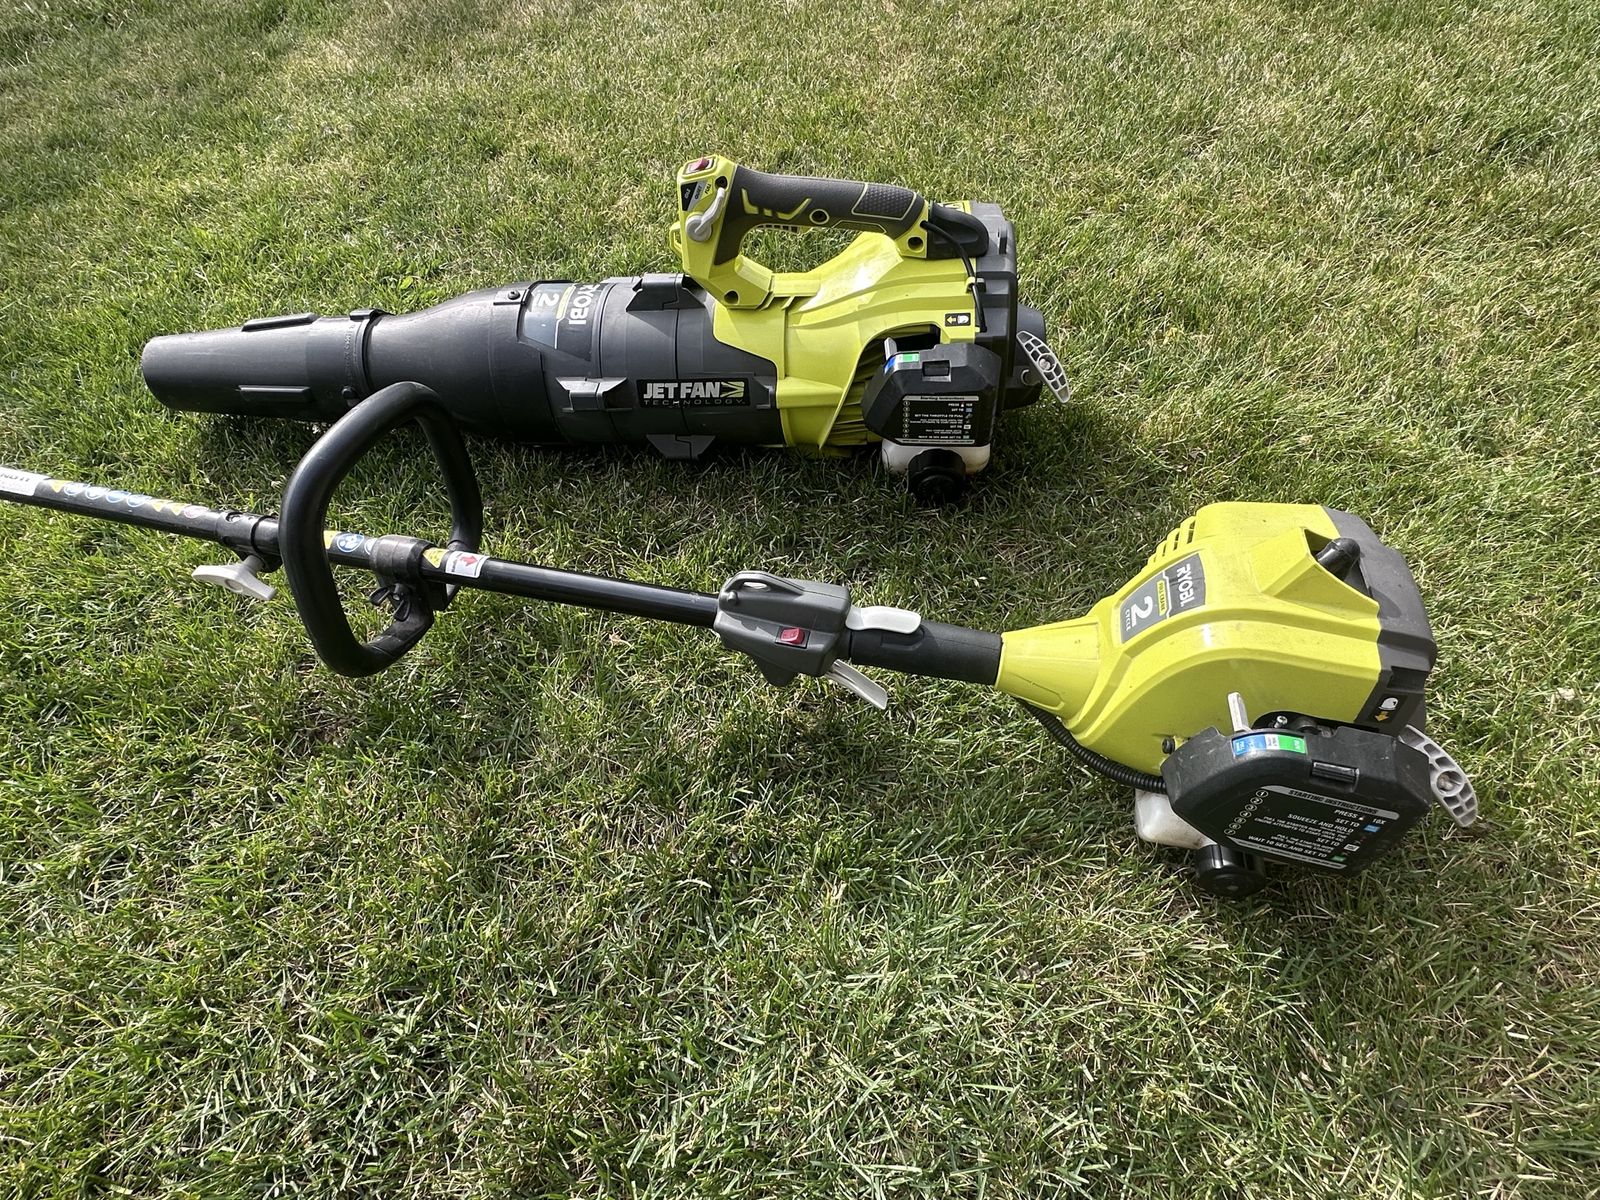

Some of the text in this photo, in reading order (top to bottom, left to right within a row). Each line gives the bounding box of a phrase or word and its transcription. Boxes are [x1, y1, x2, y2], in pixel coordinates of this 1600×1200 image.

[569, 284, 600, 325] RYOBI
[643, 381, 720, 399] JET FAN
[1176, 563, 1195, 608] RYOBI
[1130, 595, 1154, 628] 2
[1288, 789, 1379, 815] STARTING INSTRUCTIONS
[1287, 813, 1354, 834] SQUEEZE AND HOLD
[1334, 809, 1358, 819] PRESS
[1247, 835, 1265, 843] WAIT
